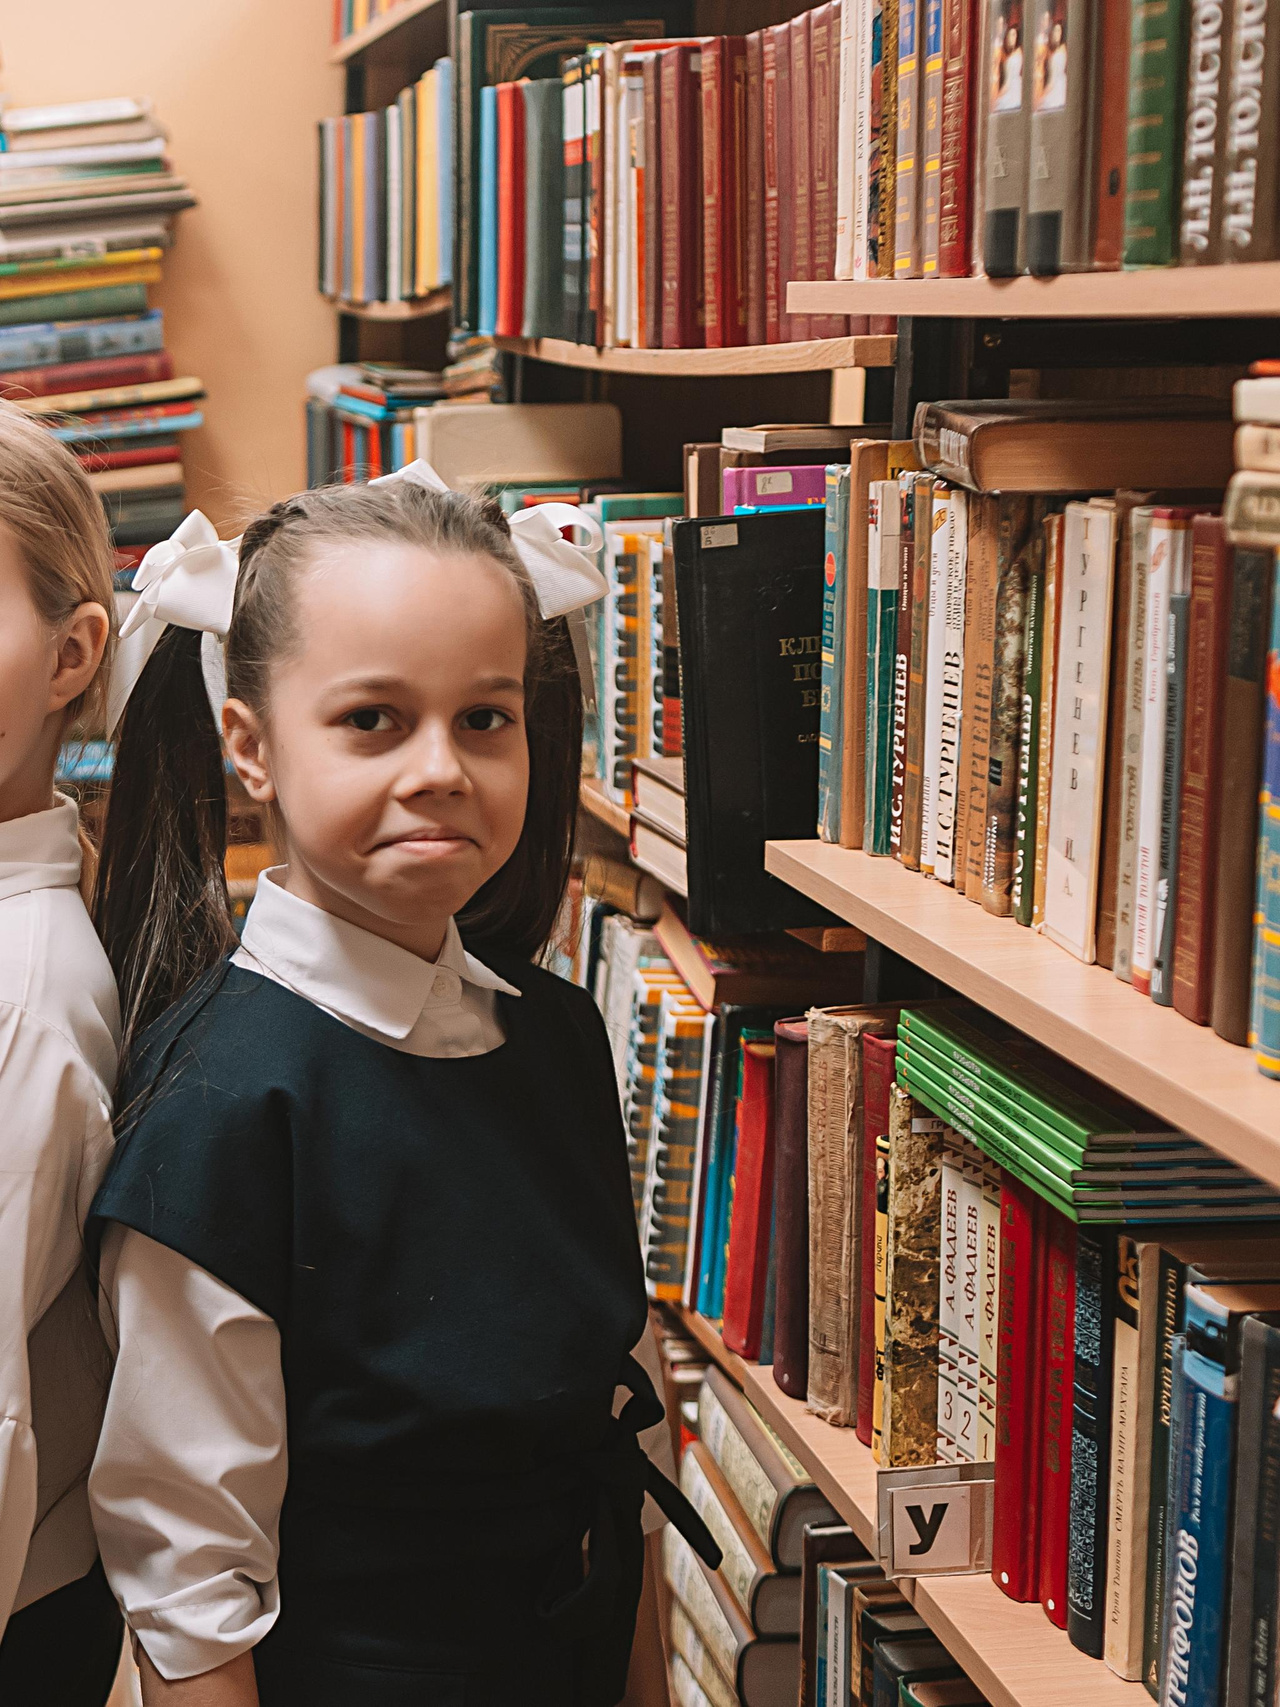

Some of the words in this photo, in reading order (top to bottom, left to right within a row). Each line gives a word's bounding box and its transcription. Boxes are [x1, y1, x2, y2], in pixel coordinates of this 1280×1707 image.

[1183, 0, 1223, 166] ТОЛСТО
[857, 110, 865, 159] КАЗАКИ
[1180, 166, 1214, 252] Л.Н.
[1221, 157, 1258, 248] Л.Н.
[945, 553, 954, 628] ДВОРЯНСКОЕ
[891, 653, 908, 787] ТУРГЕНЕВ
[938, 652, 961, 803] ТУРГЕНЕВ
[969, 662, 991, 814] ТУРГЕНЕВ
[889, 793, 903, 847] И.С.
[1138, 846, 1150, 899] ТОЛСТОЙ
[1136, 903, 1147, 958] АЛЕКСЕЙ
[944, 1188, 957, 1285] ФАДЕЕВ
[963, 1205, 978, 1302] ФАДЕЕВ
[945, 1291, 956, 1313] А.
[984, 1223, 996, 1322] ФАДЕЕВ
[963, 1307, 975, 1331] А.
[1001, 1273, 1014, 1337] ТВЕН
[1051, 1297, 1067, 1361] ТВЕН
[1163, 1268, 1178, 1361] ТЫНЯНОВ
[983, 1328, 994, 1350] А.
[943, 1390, 954, 1420] 3
[999, 1342, 1012, 1408] МАРК
[1048, 1367, 1063, 1438] МАРК
[1118, 1365, 1130, 1427] МУХТАРА
[1159, 1366, 1172, 1427] ЮРИЙ
[960, 1410, 973, 1441] 2
[1116, 1429, 1127, 1476] ВАЗИР
[1195, 1392, 1207, 1477] набережной
[1115, 1478, 1126, 1533] СМЕРТЬ
[1194, 1478, 1203, 1496] на
[905, 1502, 950, 1555] У
[1113, 1537, 1123, 1588] Тынянов
[1111, 1591, 1121, 1626] Юрий
